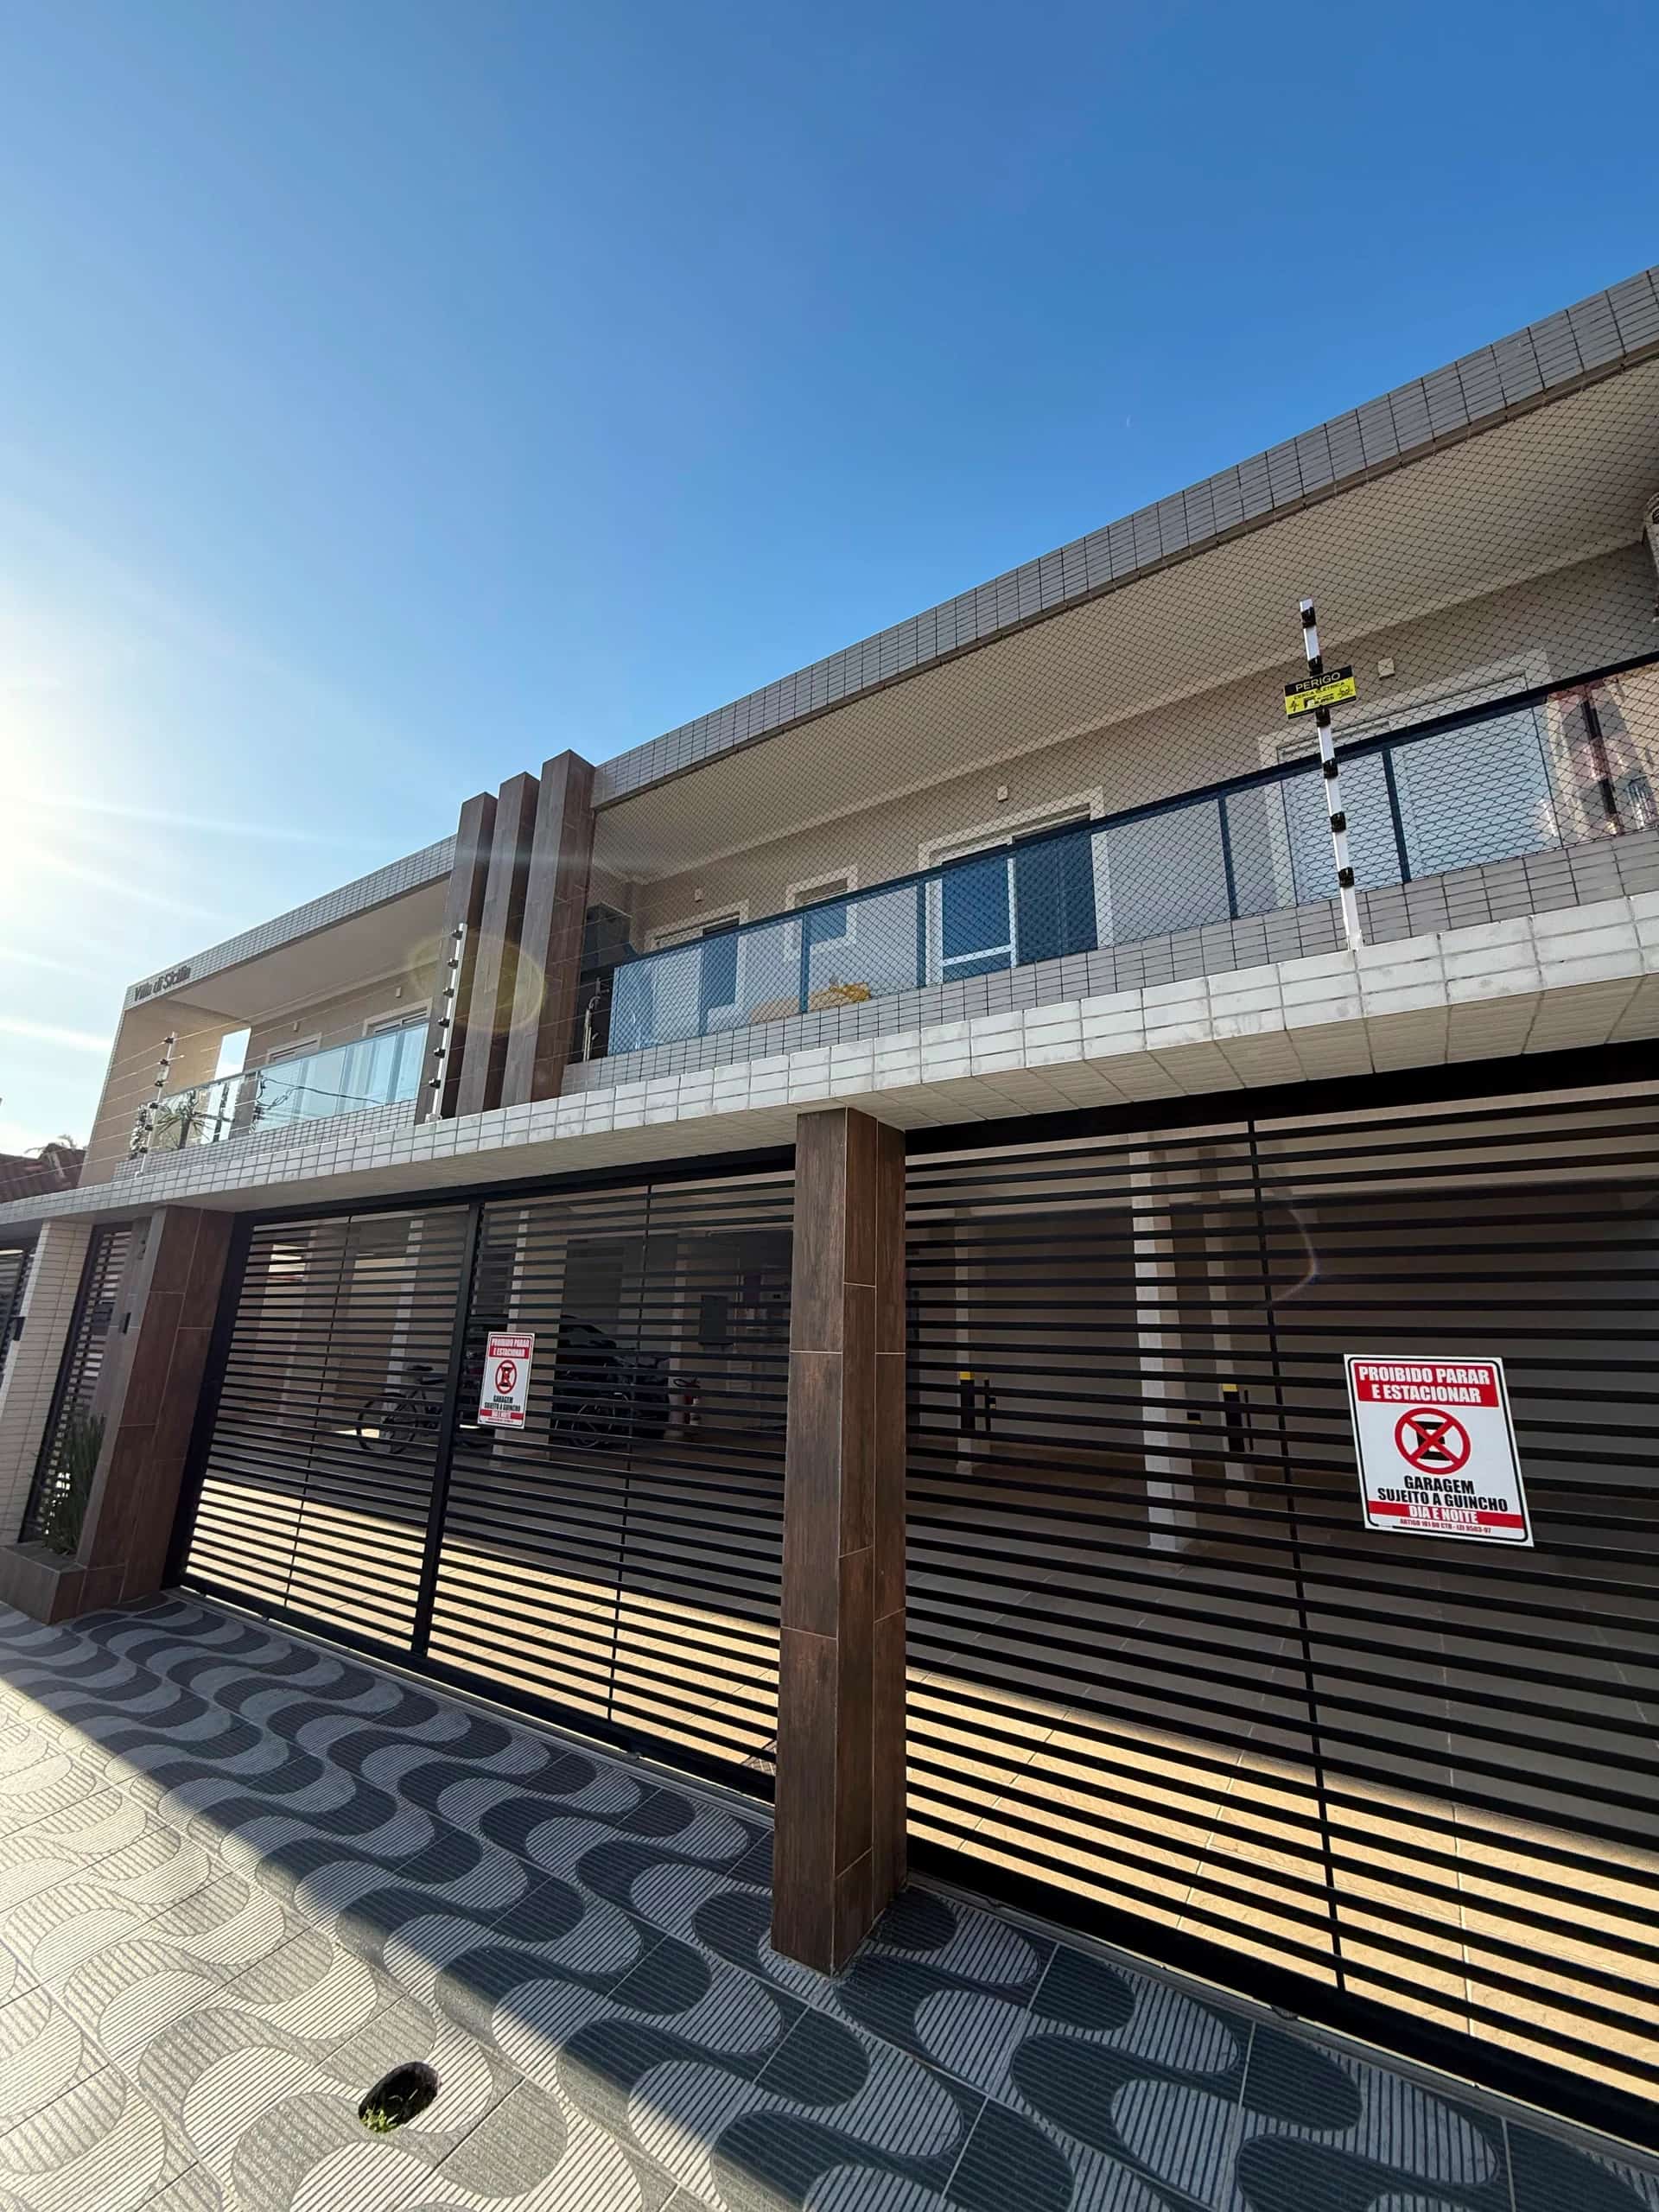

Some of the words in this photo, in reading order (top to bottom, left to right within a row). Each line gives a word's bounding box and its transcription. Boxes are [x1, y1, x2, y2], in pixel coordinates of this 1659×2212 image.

[1295, 672, 1340, 691] PERIGO
[135, 982, 153, 1001] Villa
[153, 976, 163, 993] di
[1358, 1366, 1433, 1382] PROIBIDO
[1436, 1368, 1491, 1385] PARAR
[1372, 1384, 1382, 1399] E
[1383, 1384, 1482, 1403] ESTACIONAR
[1404, 1476, 1475, 1494] GARAGEM
[1378, 1488, 1429, 1505] SUJEITO
[1433, 1492, 1442, 1506] A
[1444, 1493, 1508, 1512] GUINCHO
[1408, 1505, 1431, 1519] DIA
[1432, 1507, 1440, 1520] E
[1441, 1508, 1478, 1523] NOITE
